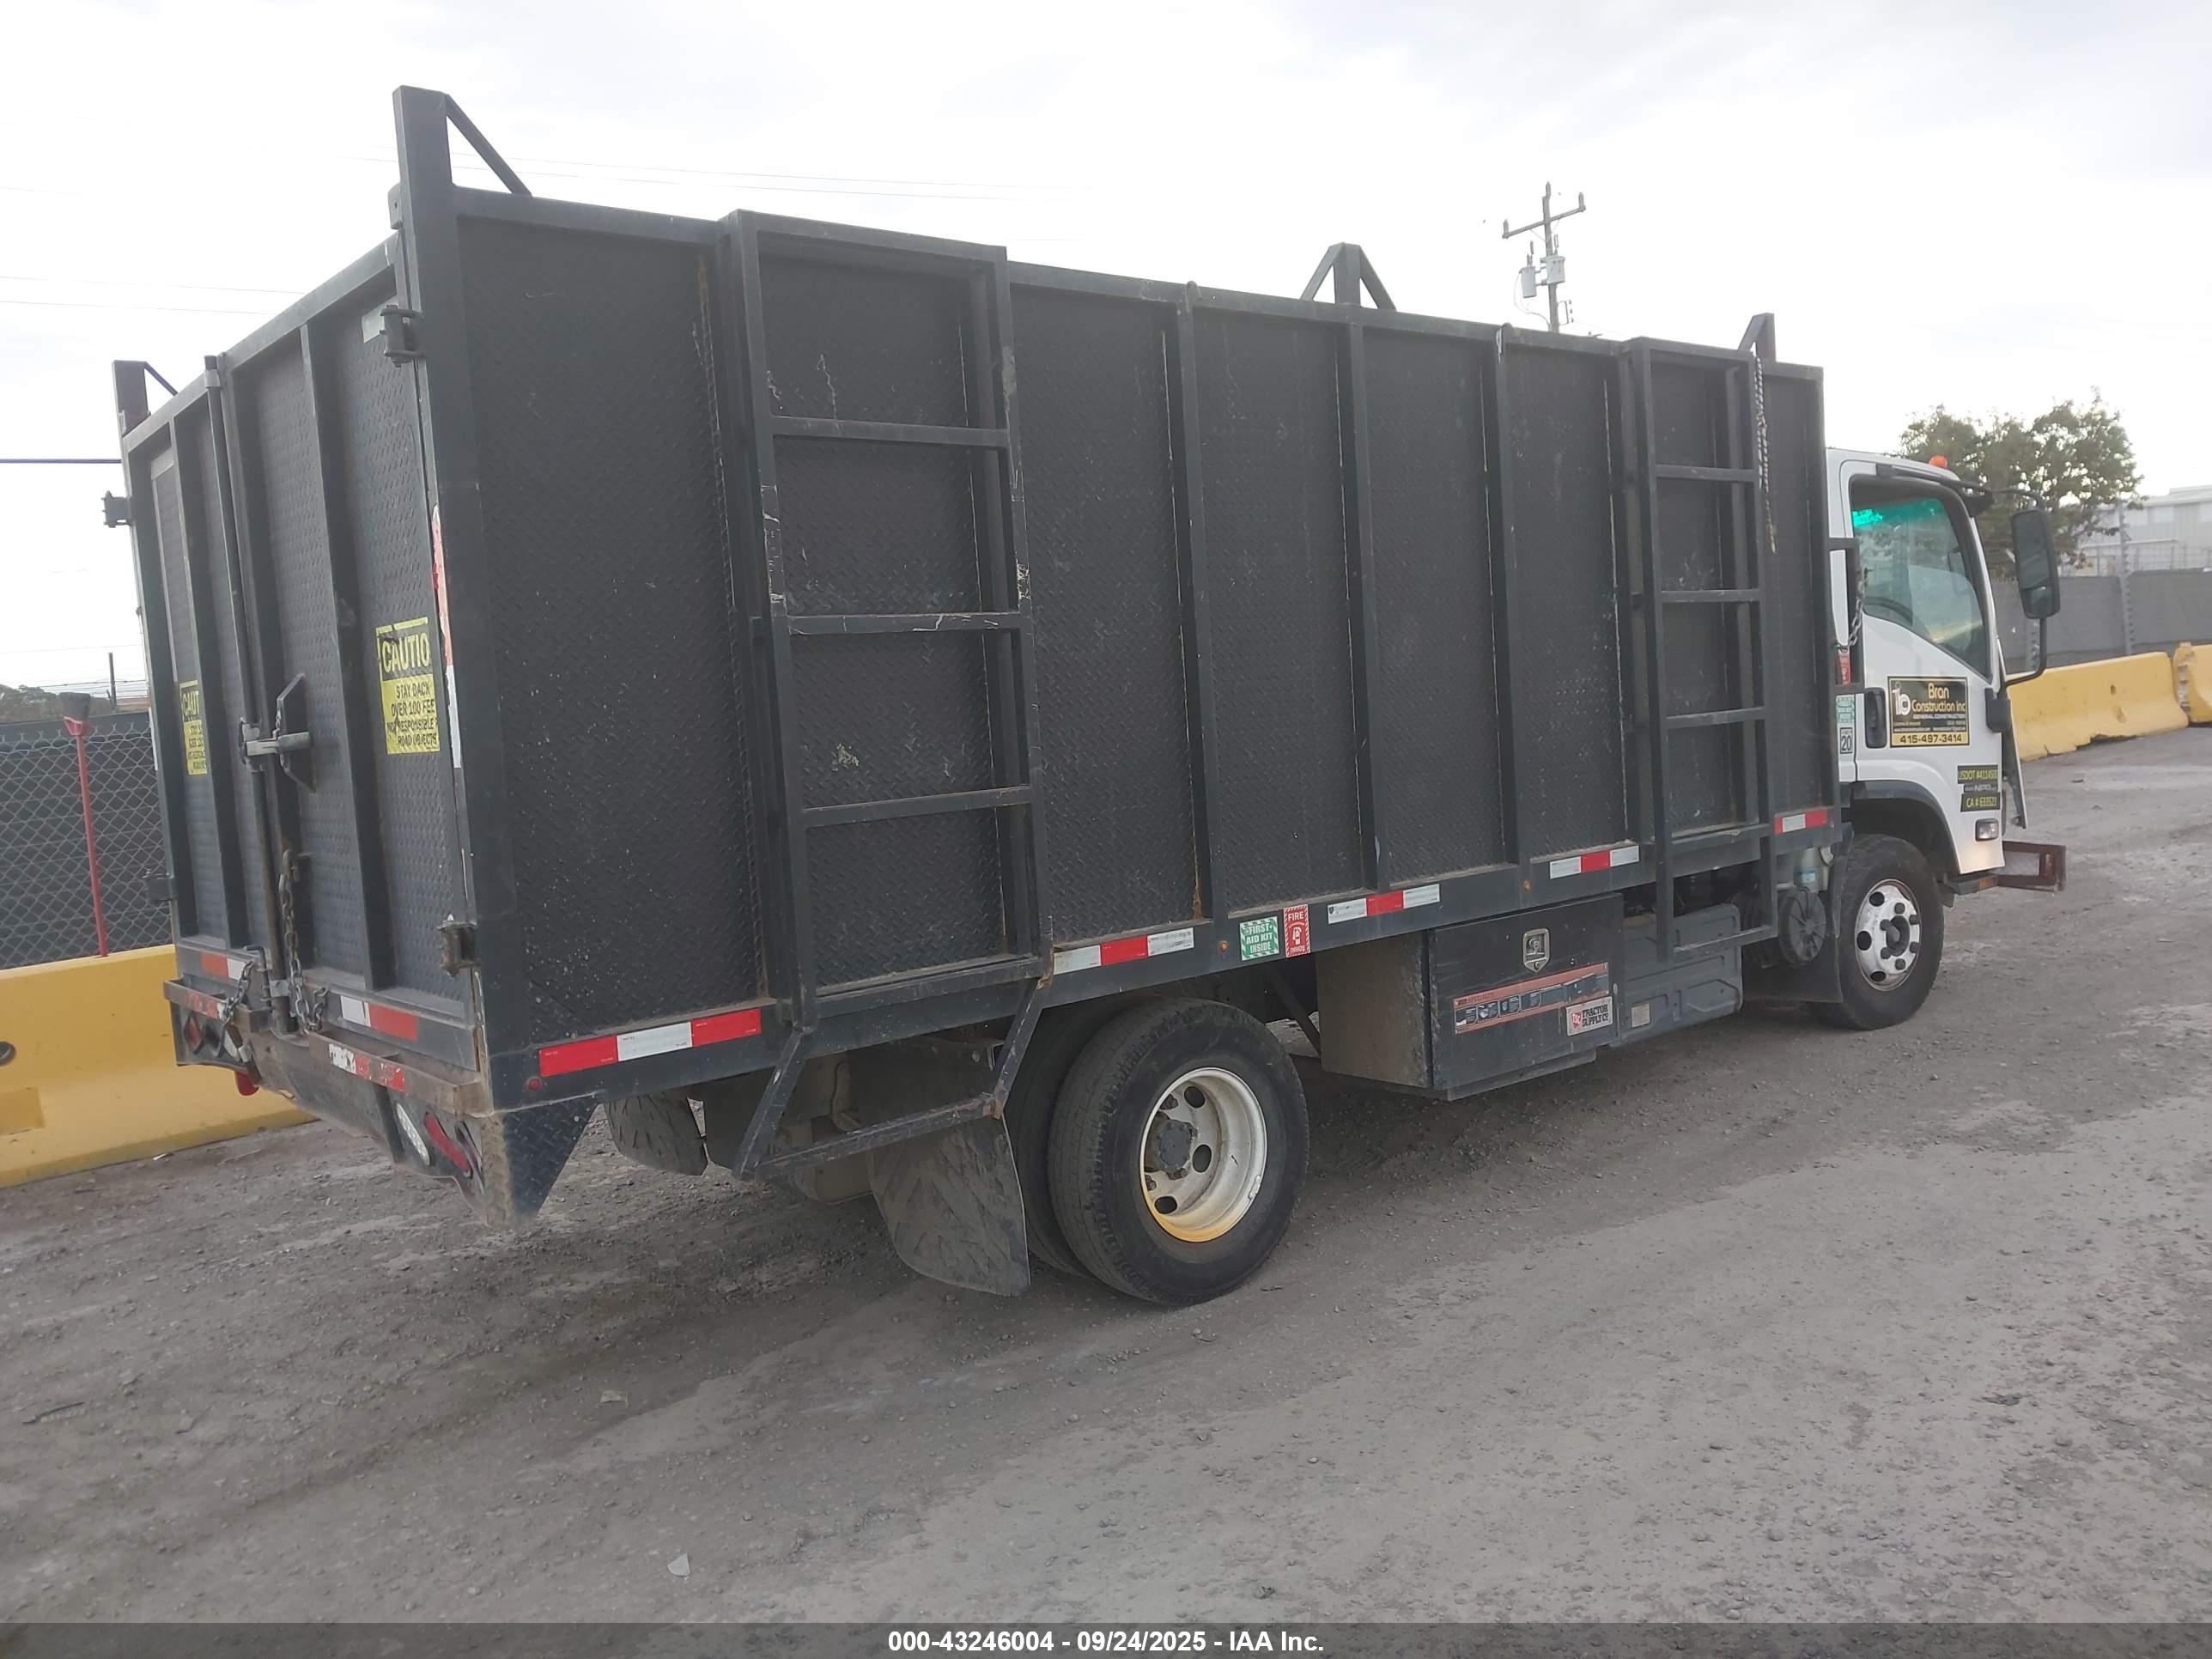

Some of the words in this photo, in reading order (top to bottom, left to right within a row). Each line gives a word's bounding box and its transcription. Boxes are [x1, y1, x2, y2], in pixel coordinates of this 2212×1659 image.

[382, 632, 429, 673] CAUTIO
[396, 684, 410, 699] STAY
[412, 681, 430, 697] BACK
[1928, 683, 1949, 700] Bran
[391, 702, 408, 717] OVER
[409, 700, 421, 715] 100
[422, 698, 435, 714] FEE
[1911, 699, 1954, 712] Construction
[1841, 735, 1851, 752] 20
[1899, 734, 1962, 744] 415-497-3414
[1288, 911, 1304, 921] FIRE
[1246, 934, 1259, 944] AID
[1261, 933, 1273, 943] KIT
[1249, 943, 1272, 953] INSIDE
